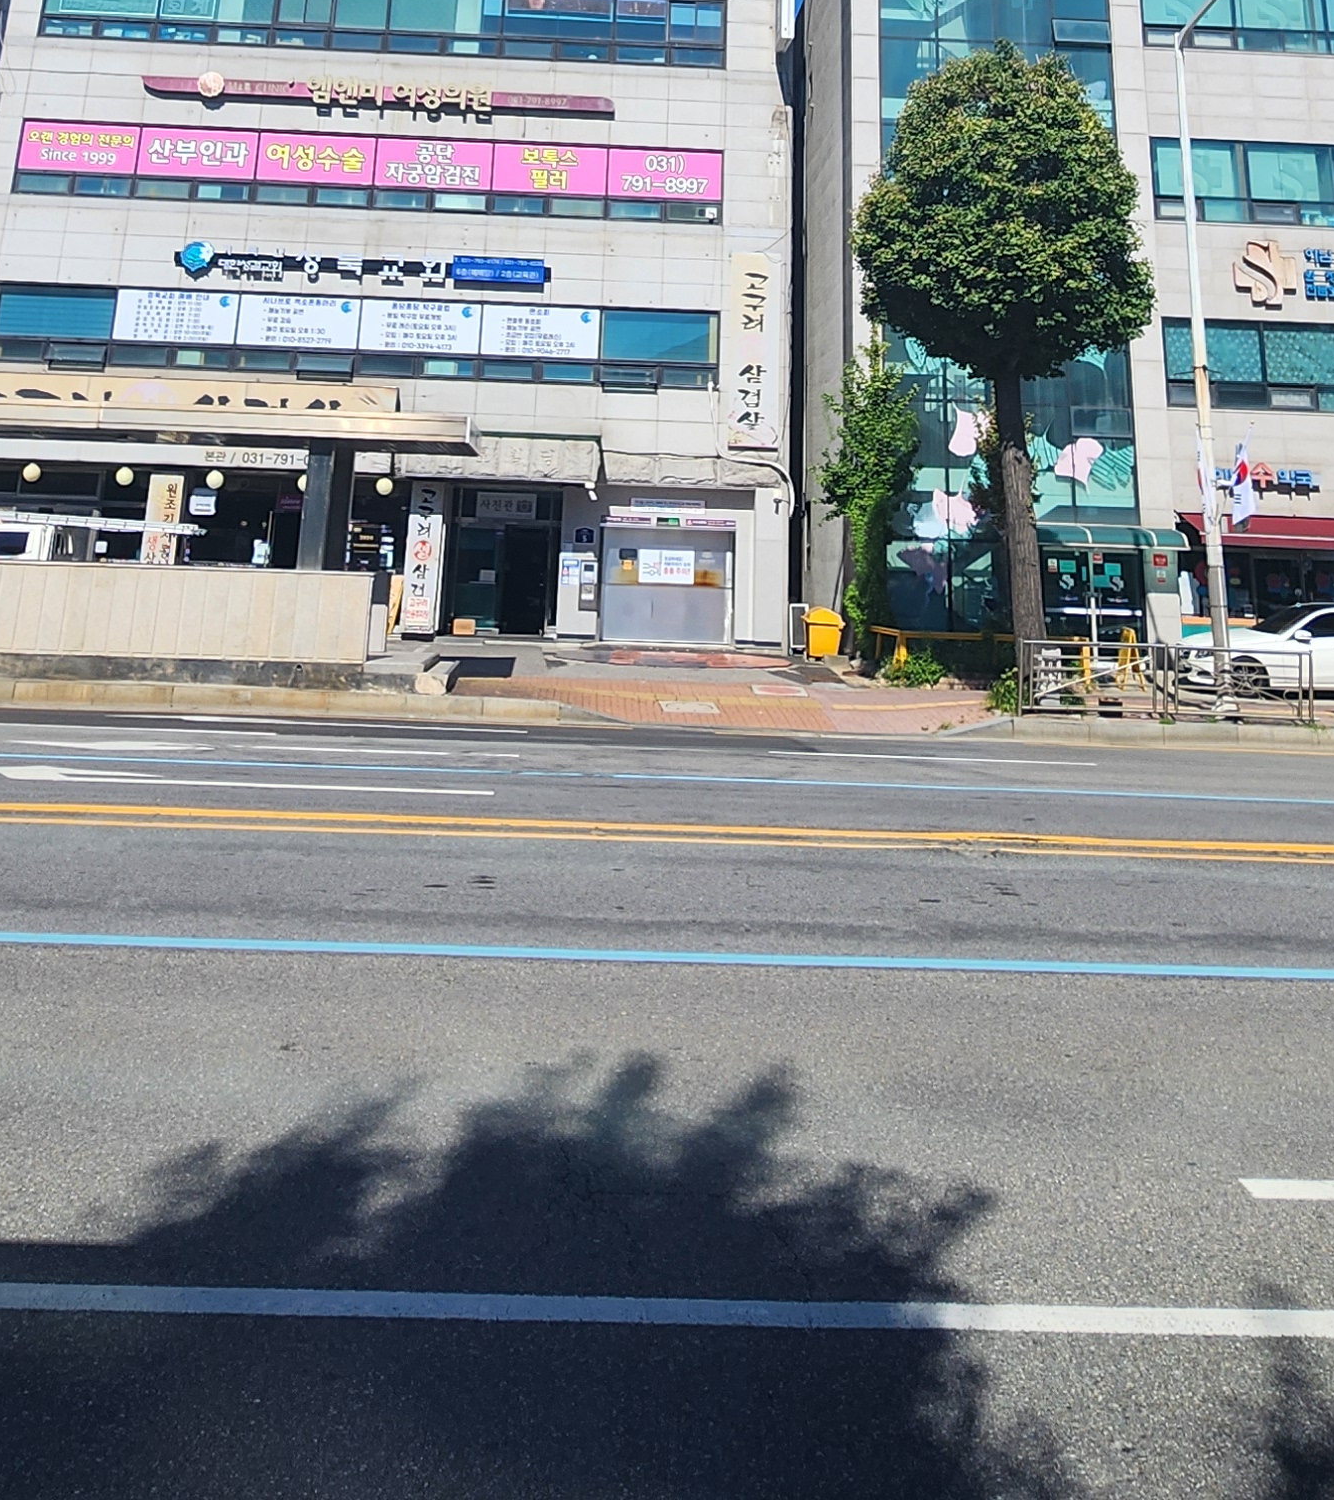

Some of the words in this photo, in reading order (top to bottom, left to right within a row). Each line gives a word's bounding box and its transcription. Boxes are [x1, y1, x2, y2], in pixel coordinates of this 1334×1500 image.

[307, 74, 383, 106] 엠앤비
[392, 78, 494, 111] 여성의원
[27, 130, 53, 144] 오랜
[56, 132, 94, 146] 경험의
[97, 134, 135, 148] 전문의
[40, 148, 78, 162] Since
[81, 151, 117, 166] 1999
[148, 137, 249, 168] 산부인과
[267, 143, 367, 173] 여성수술
[416, 143, 455, 163] 공단
[521, 148, 579, 169] 보톡스
[385, 162, 481, 187] 자궁암검진
[645, 155, 685, 175] 031)
[529, 169, 568, 190] 필러
[621, 175, 710, 195] 791-8997
[741, 272, 769, 333] 고구려
[736, 364, 767, 431] 삼겹살
[204, 451, 226, 463] 본관
[417, 488, 437, 539] 고구려
[480, 499, 513, 513] 사진관
